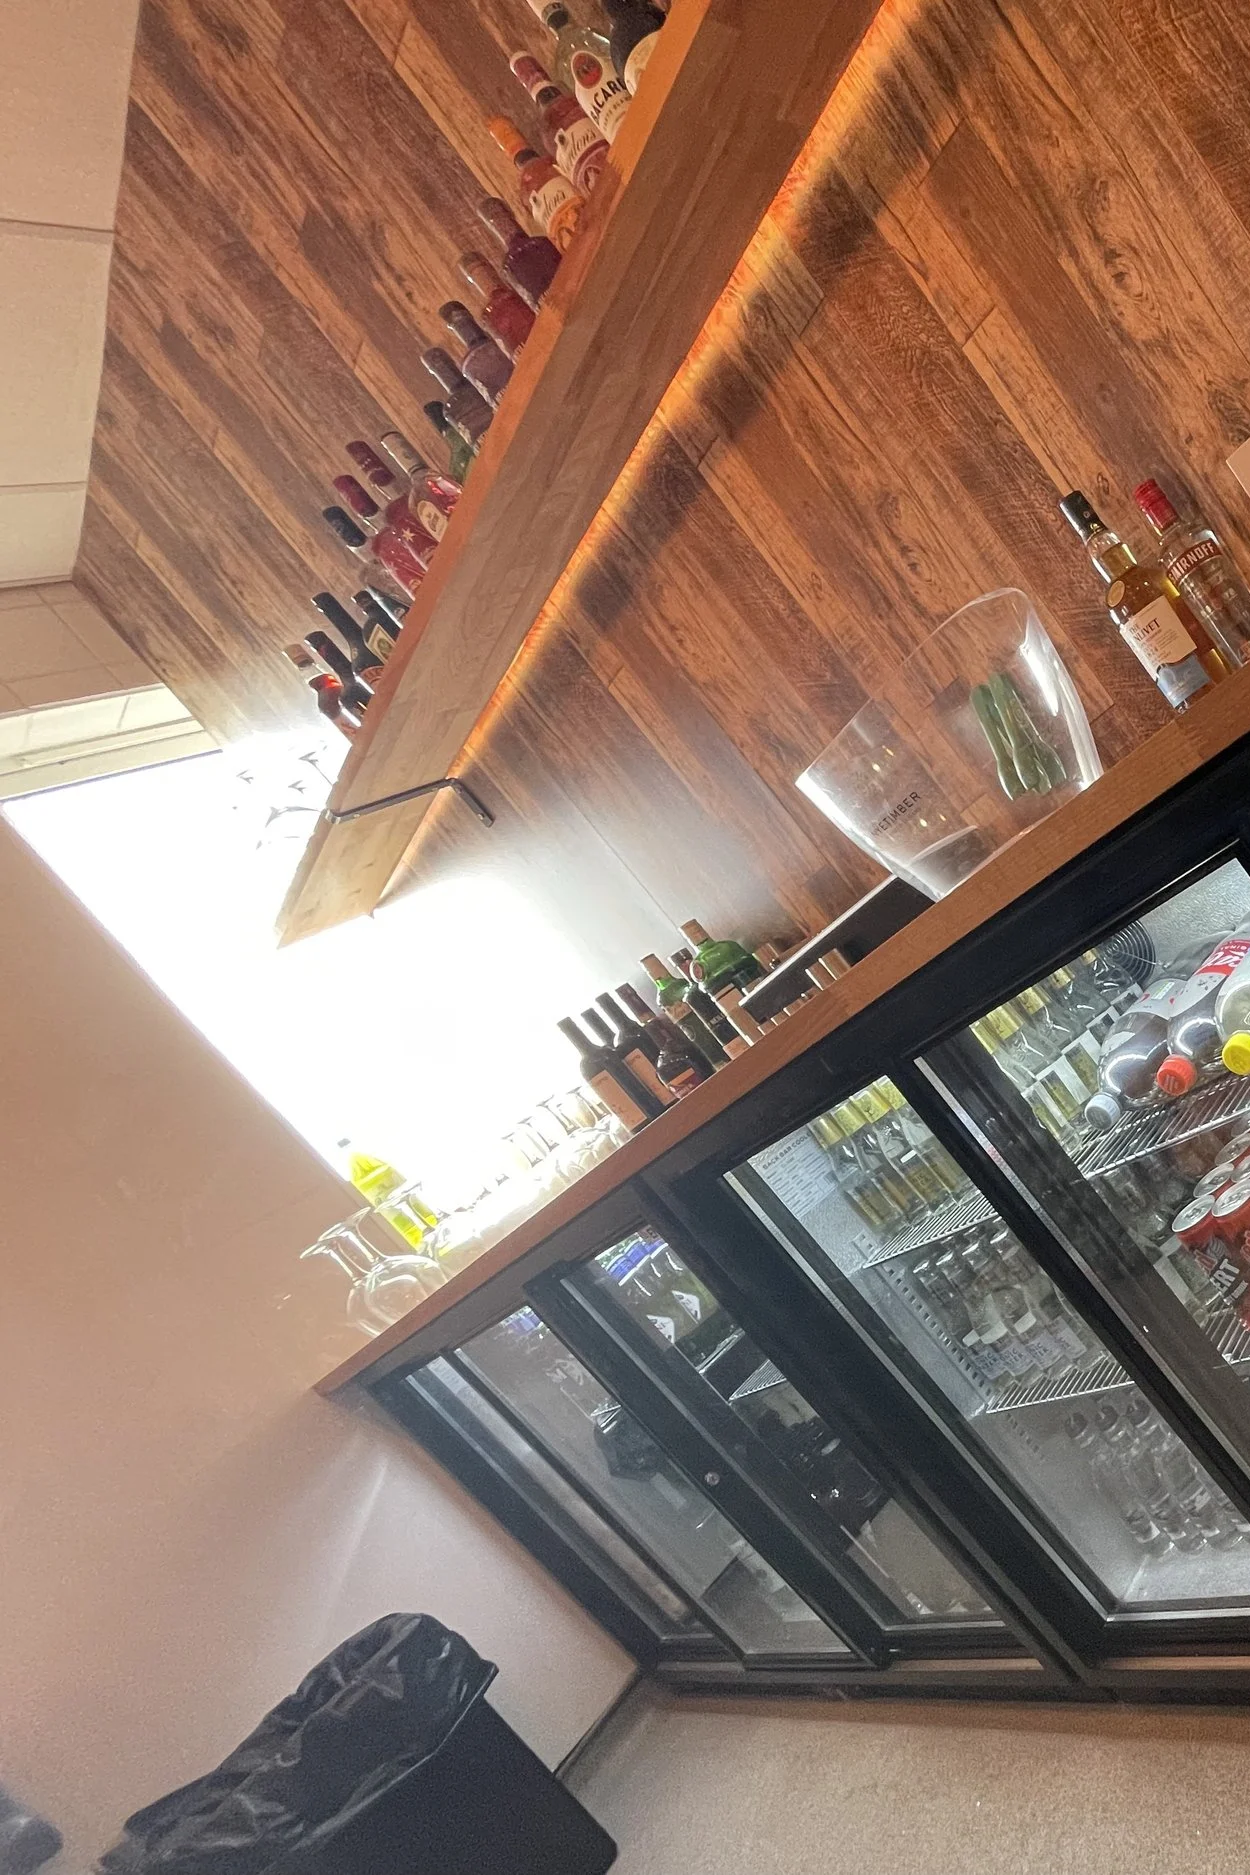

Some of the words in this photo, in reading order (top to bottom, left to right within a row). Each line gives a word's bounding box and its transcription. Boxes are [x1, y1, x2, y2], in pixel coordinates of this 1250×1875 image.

[591, 77, 625, 122] BACAR
[1168, 543, 1215, 583] SMIRNOFF
[1210, 1259, 1240, 1296] ERT
